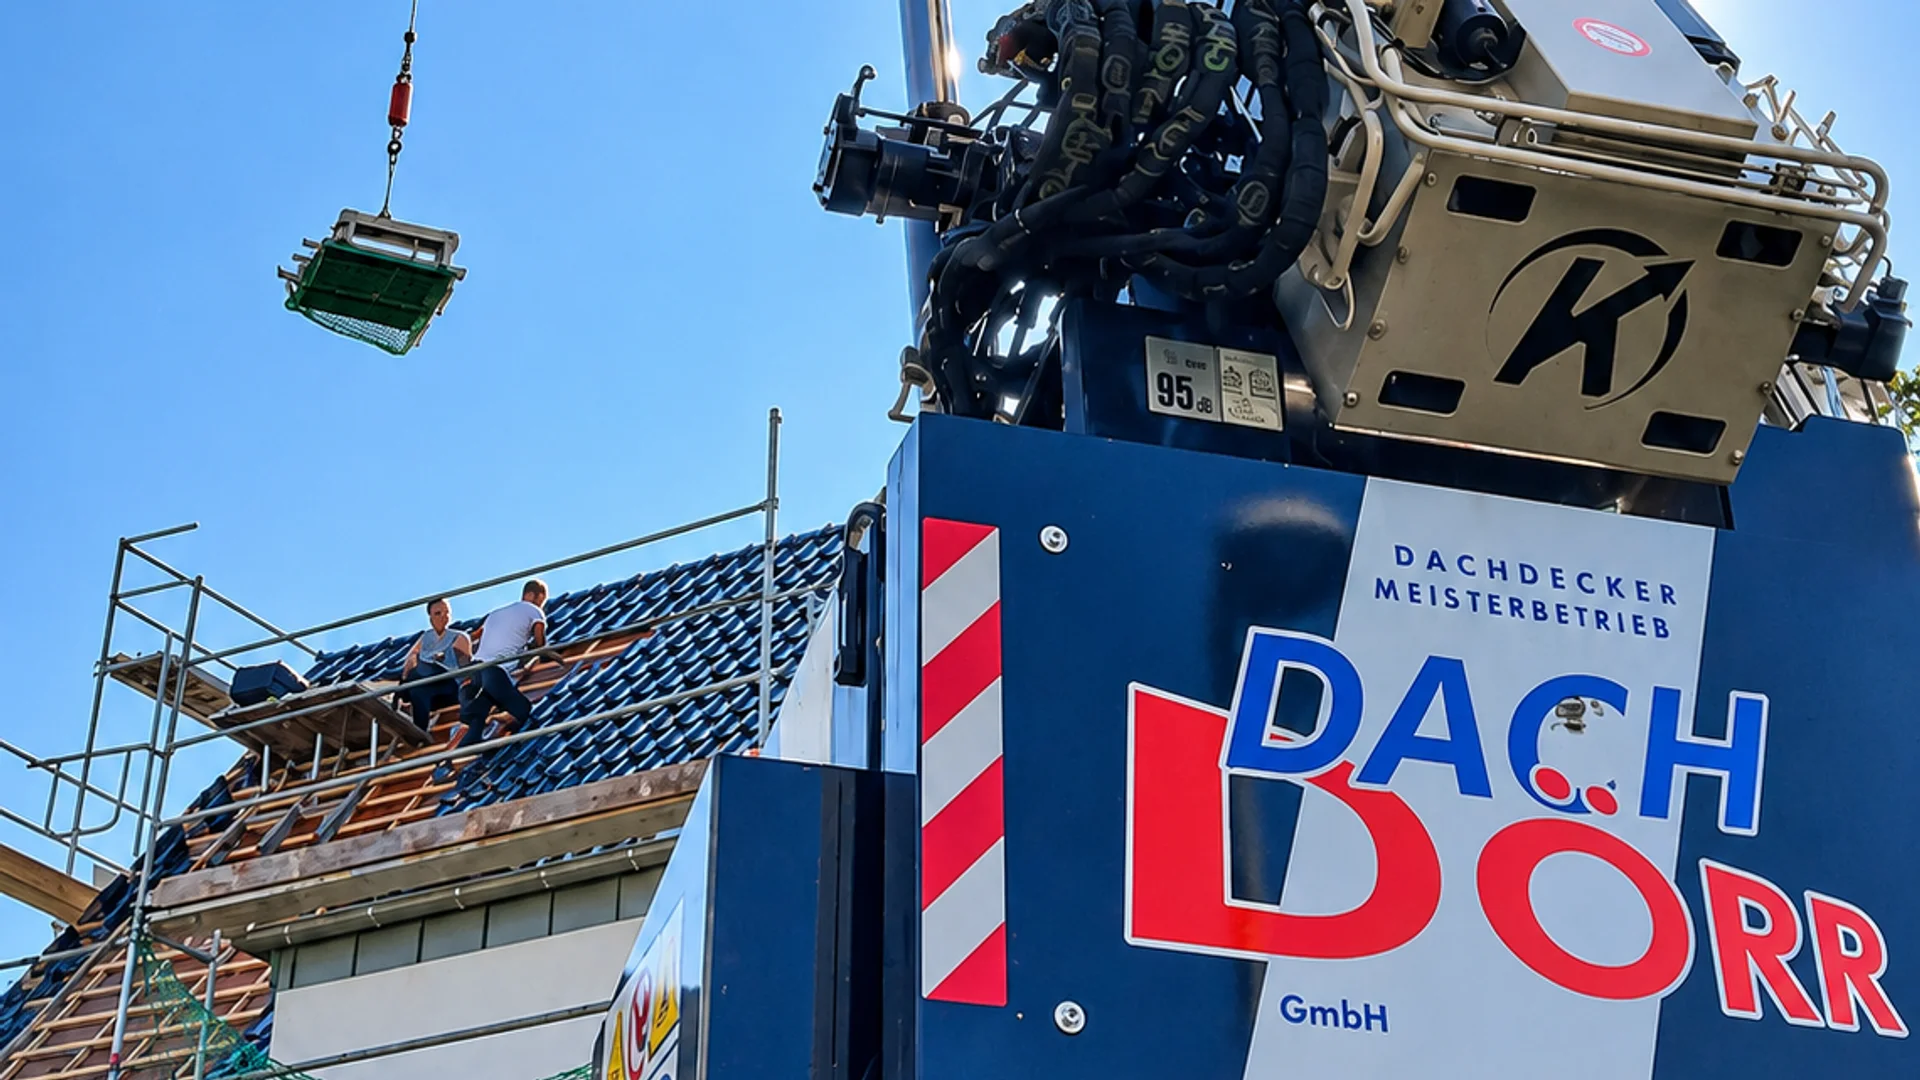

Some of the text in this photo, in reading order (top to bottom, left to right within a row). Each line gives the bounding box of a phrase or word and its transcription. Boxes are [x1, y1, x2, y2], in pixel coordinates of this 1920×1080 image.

[1156, 371, 1194, 411] 95
[1196, 395, 1214, 415] dB
[1393, 544, 1678, 606] DACHDECKER
[1374, 577, 1671, 640] MEISTERBETRIEB
[1221, 629, 1768, 833] DACH
[1127, 683, 1908, 1036] DÖRR
[1279, 993, 1389, 1033] GmbH
